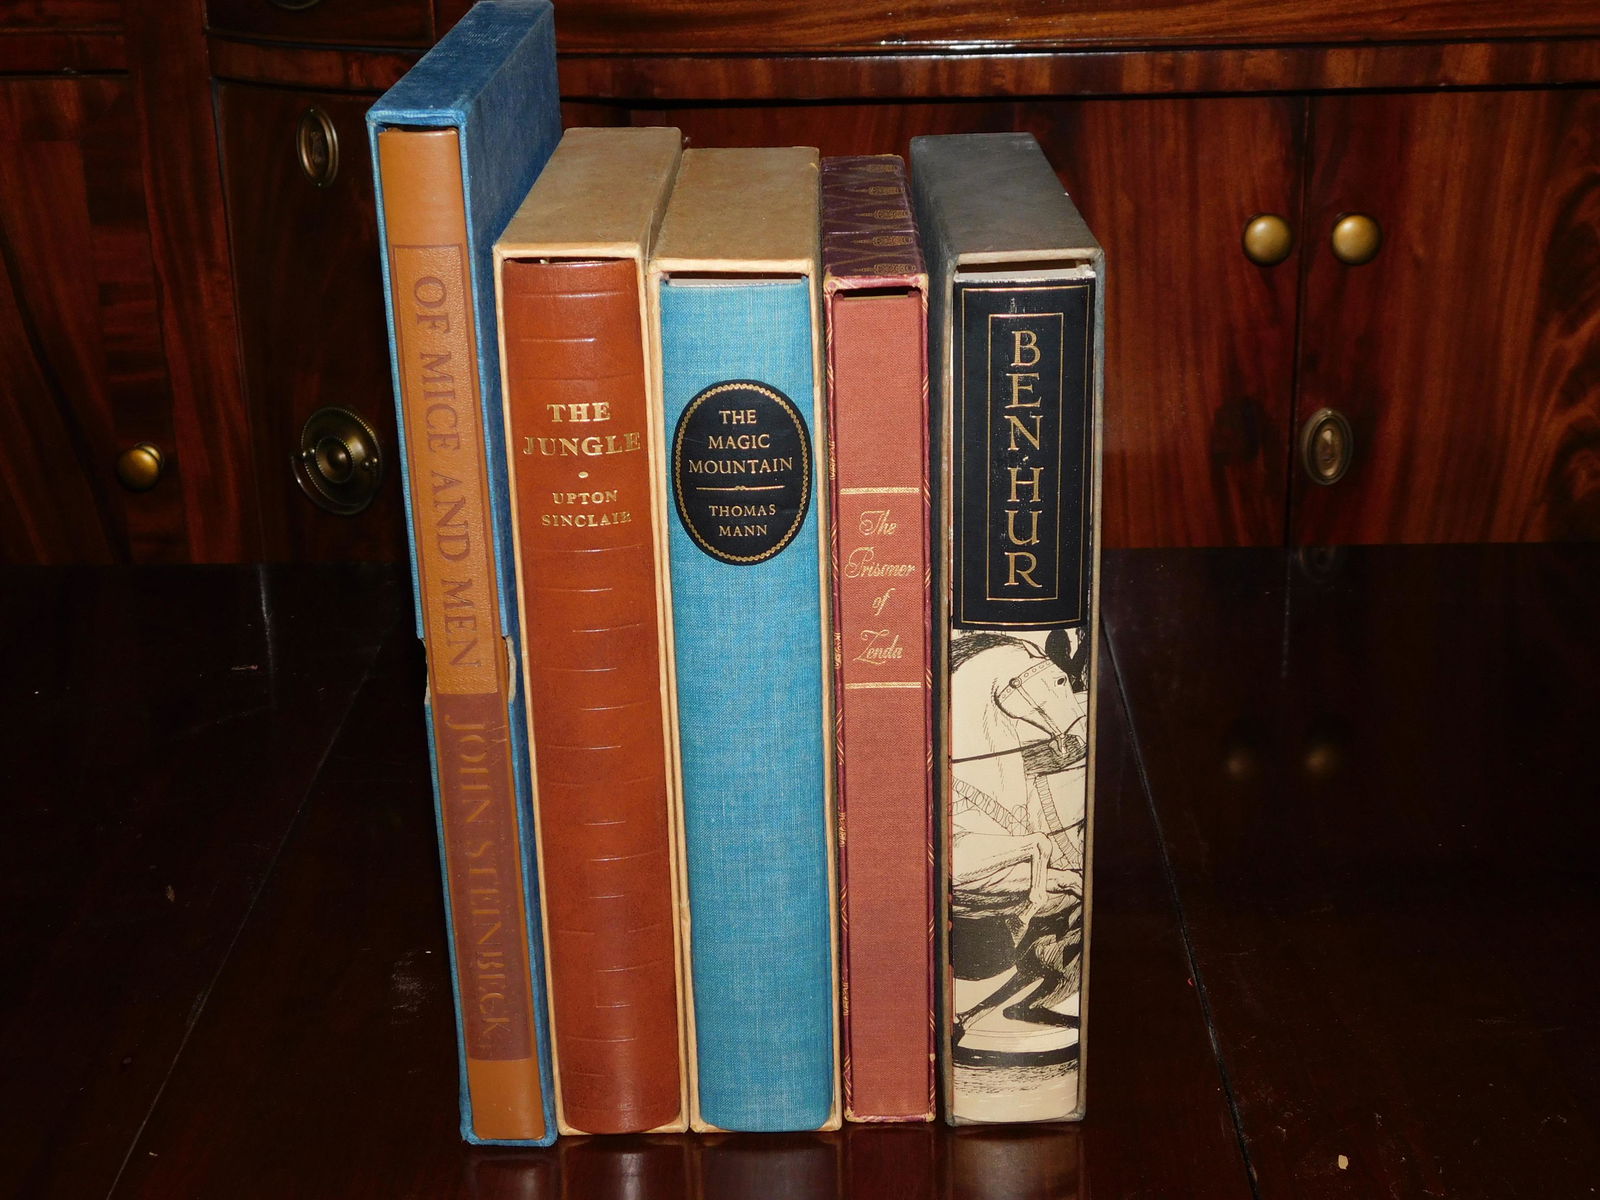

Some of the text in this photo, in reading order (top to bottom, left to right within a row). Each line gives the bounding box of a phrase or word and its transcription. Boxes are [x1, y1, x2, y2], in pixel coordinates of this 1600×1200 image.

[547, 402, 611, 423] THE
[718, 410, 758, 425] THE
[523, 431, 641, 456] JUNGLE
[708, 434, 771, 450] MAGIC
[414, 276, 482, 668] OF MICE AND MEN
[688, 457, 793, 475] MOUNTAIN
[552, 489, 618, 505] UPTON
[541, 511, 632, 527] SINCLAIR
[708, 504, 776, 517] THOMAS
[718, 525, 768, 537] MANN
[859, 509, 897, 536] The
[844, 546, 916, 578] Prisoner
[872, 588, 896, 616] of
[853, 629, 903, 665] Zenda
[445, 715, 493, 824] JOHN
